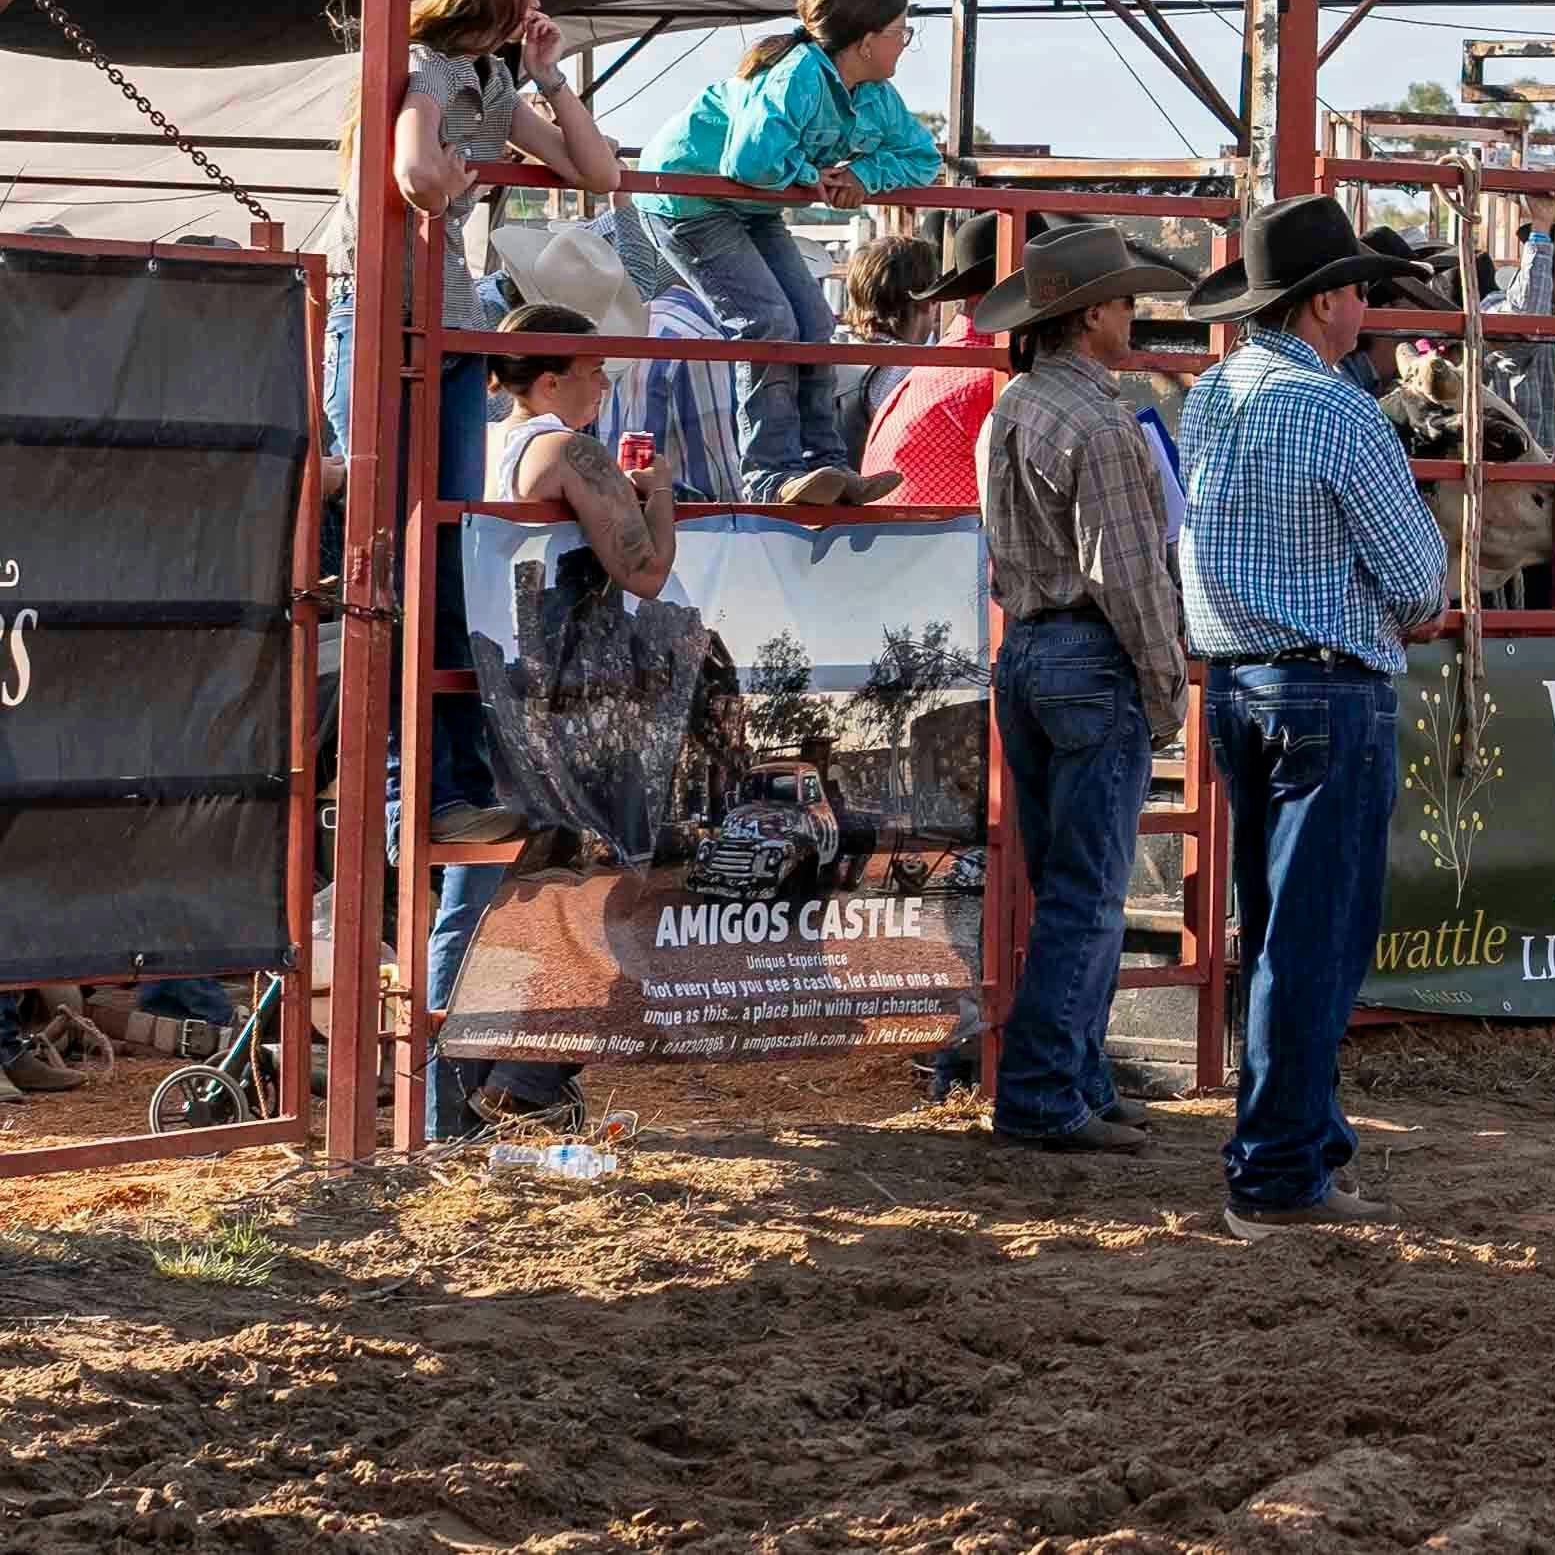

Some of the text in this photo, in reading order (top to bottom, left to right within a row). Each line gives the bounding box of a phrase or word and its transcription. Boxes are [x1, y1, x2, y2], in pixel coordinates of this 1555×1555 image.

[655, 897, 923, 947] AMIGOS CASTLE
[1376, 909, 1507, 969] wattle
[747, 951, 848, 971] Unique Experience
[674, 981, 710, 999] every
[712, 978, 737, 998] day
[739, 979, 764, 996] you
[766, 977, 790, 992] see
[793, 977, 801, 991] a
[848, 971, 868, 988] let
[869, 970, 904, 988] alone
[906, 973, 930, 987] one
[933, 972, 950, 987] as
[685, 1009, 700, 1024] as
[703, 1004, 738, 1023] this...
[742, 1006, 750, 1021] a
[753, 1001, 789, 1023] place
[792, 999, 822, 1017] built
[824, 998, 852, 1017] with
[855, 998, 879, 1015] real
[882, 997, 943, 1015] character.
[462, 1027, 513, 1046] Sunflash
[550, 1032, 607, 1054] Lightning
[608, 1034, 645, 1055] Ridge
[876, 1028, 898, 1044] Pet
[900, 1027, 949, 1043] Friendly
